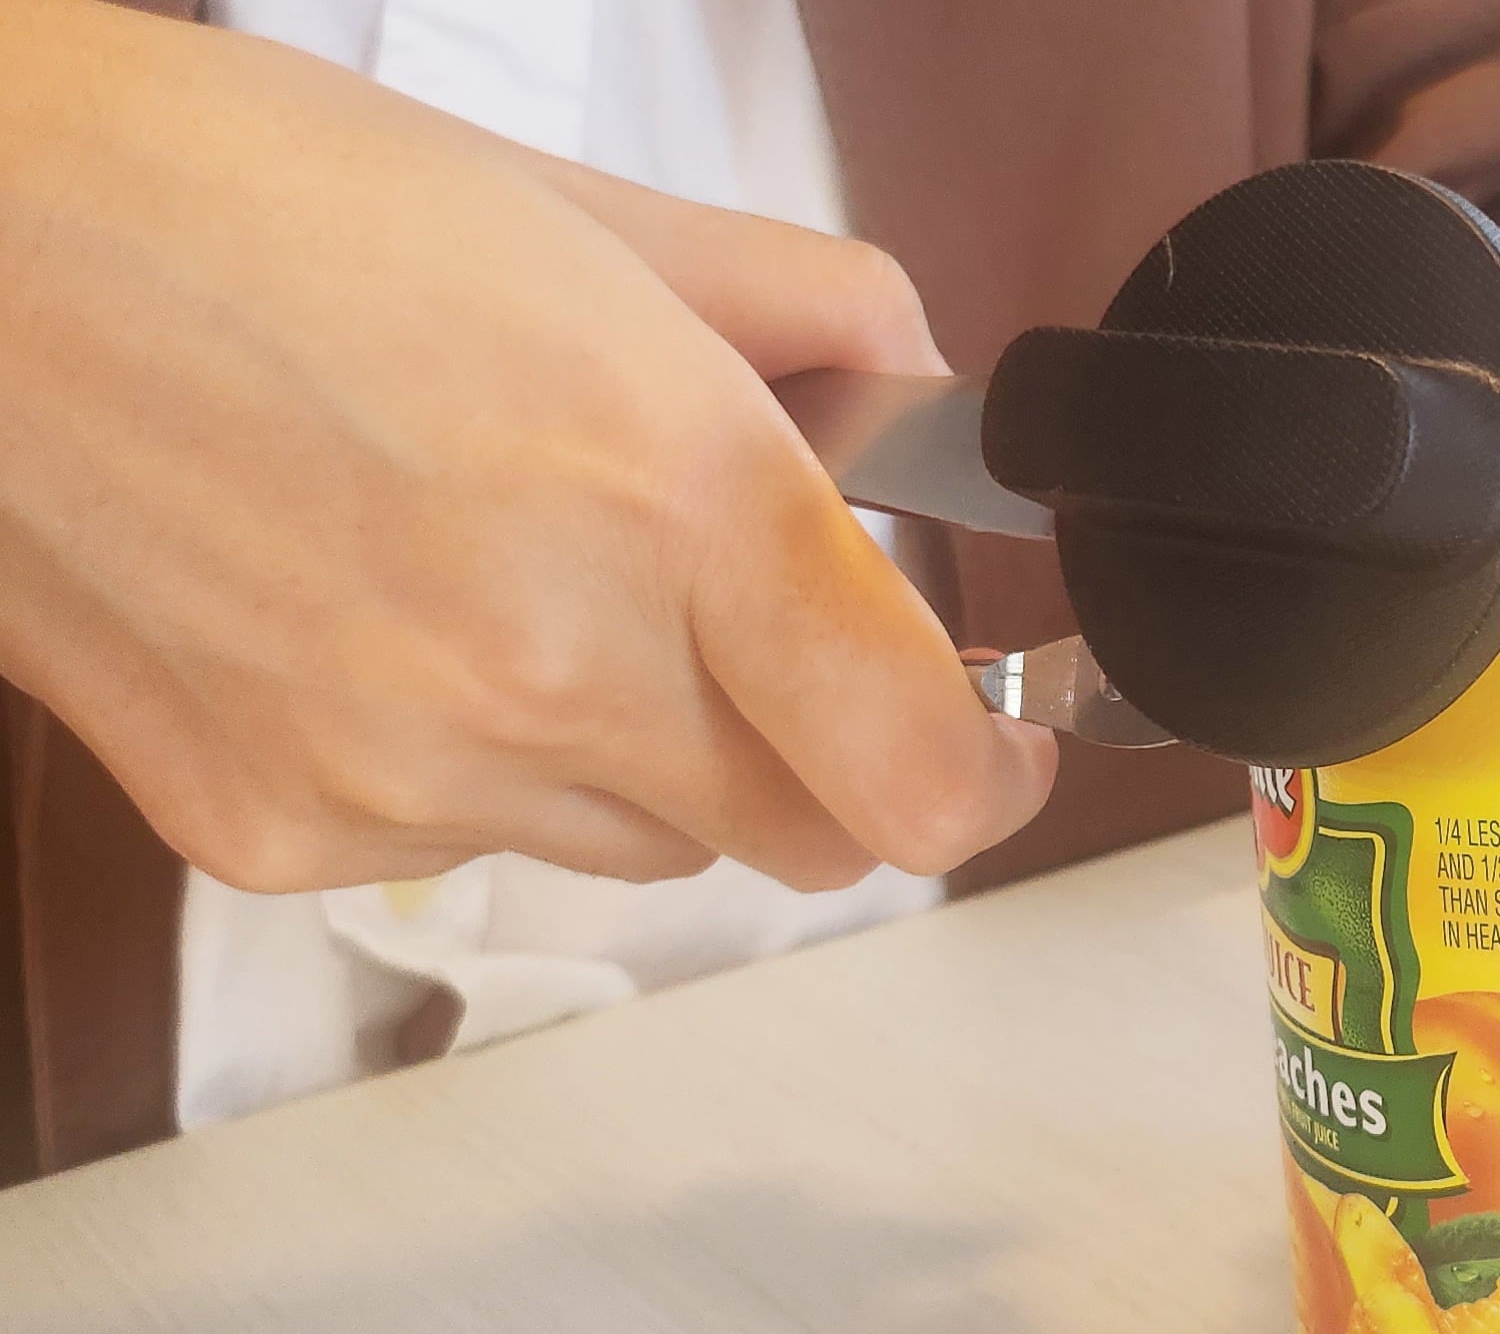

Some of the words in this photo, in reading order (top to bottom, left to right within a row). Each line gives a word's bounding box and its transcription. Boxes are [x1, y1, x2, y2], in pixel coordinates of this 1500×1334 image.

[1435, 817, 1461, 846] 1/4
[1438, 852, 1475, 881] AND
[1438, 886, 1488, 916] THAN
[1442, 920, 1460, 948] IN
[1263, 925, 1315, 1012] UICE
[1274, 1036, 1388, 1135] aches
[1313, 1120, 1340, 1152] JUICE
